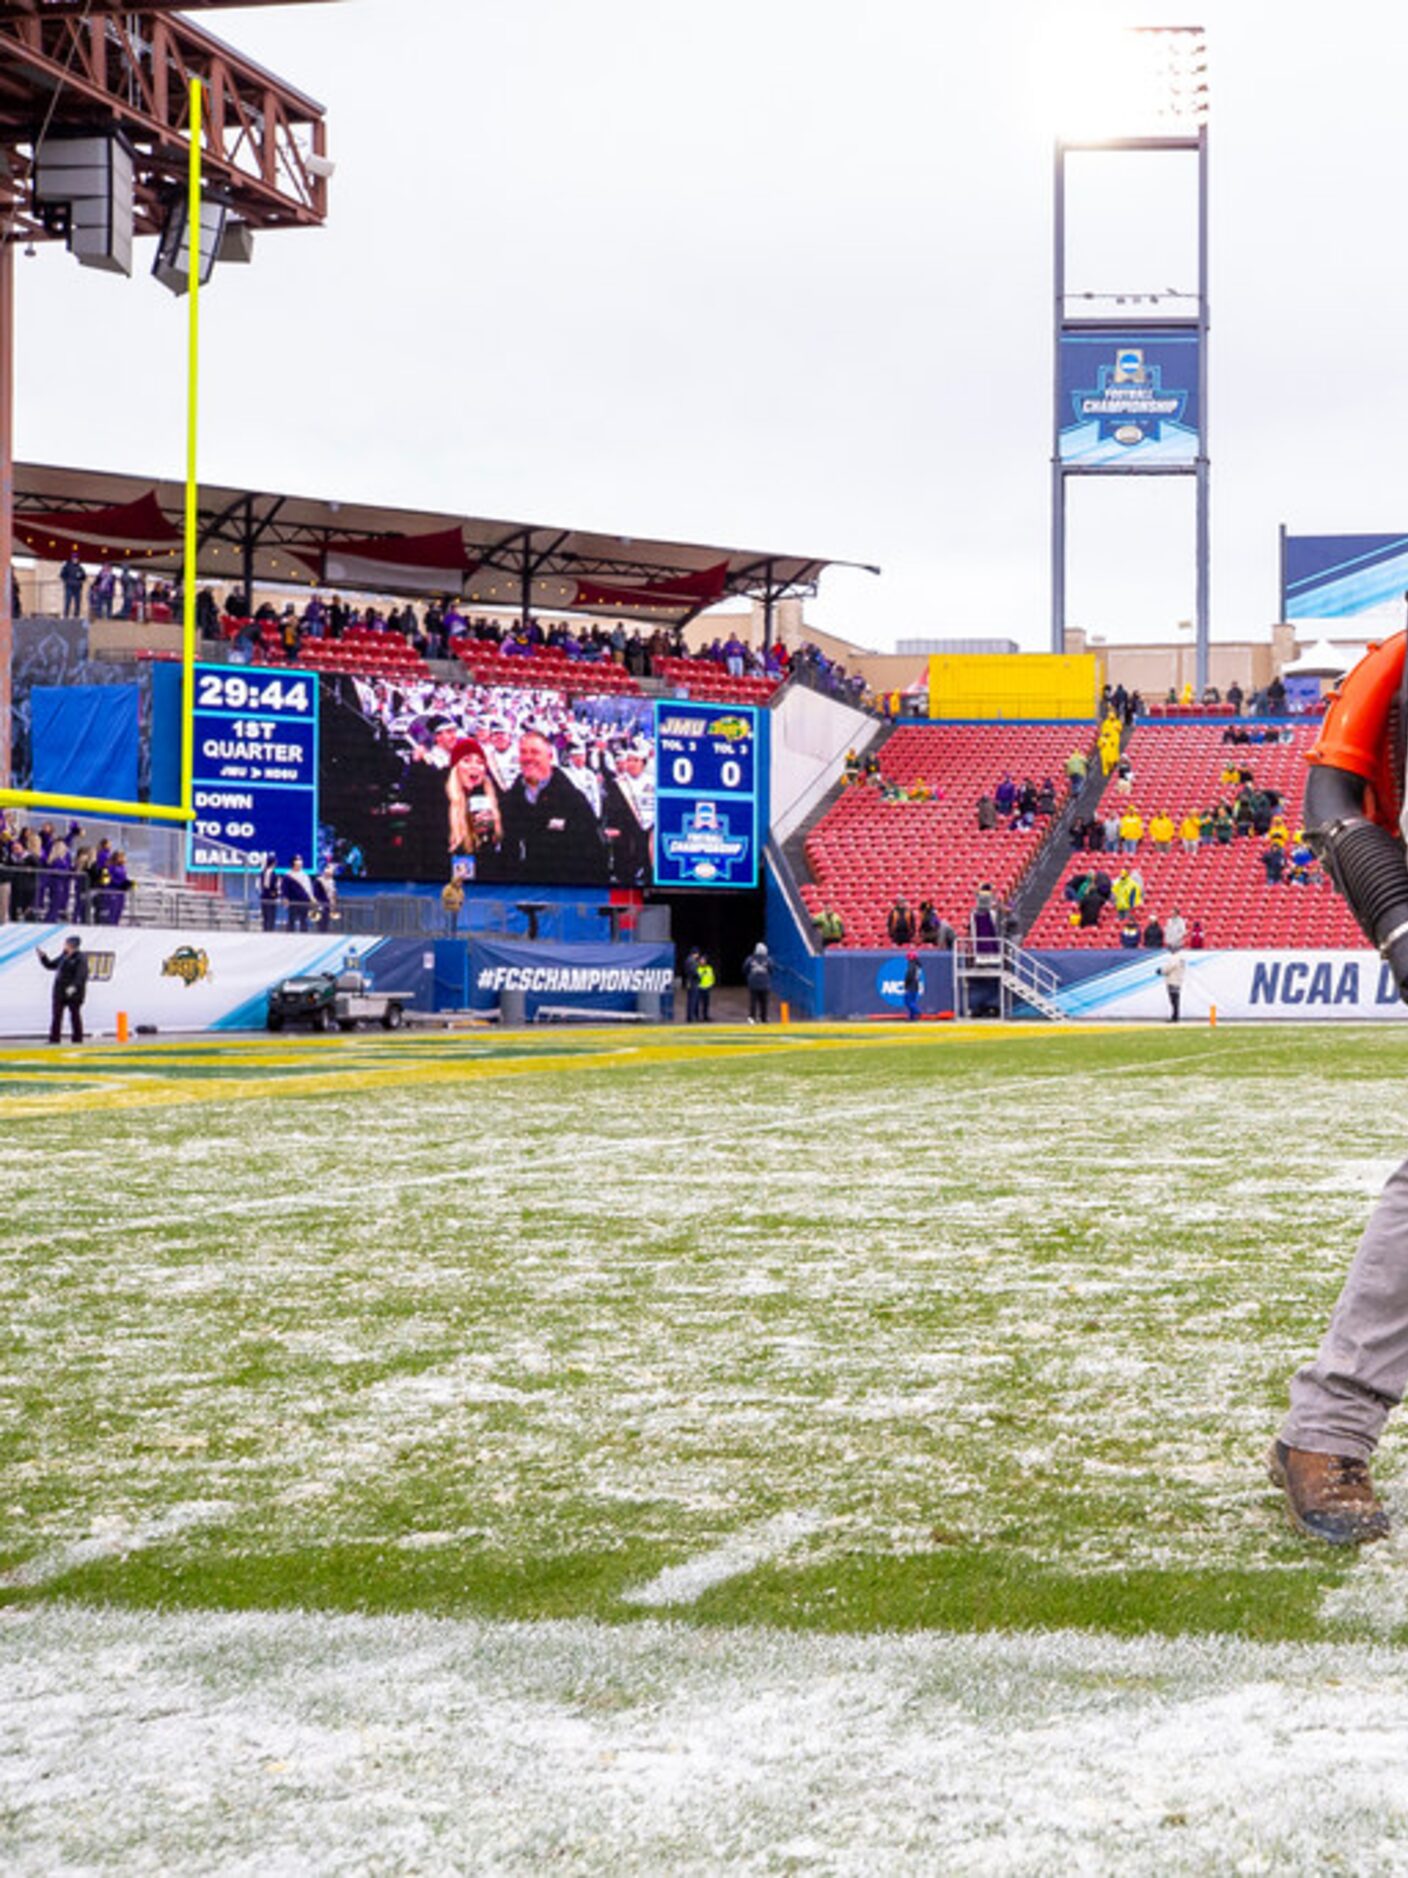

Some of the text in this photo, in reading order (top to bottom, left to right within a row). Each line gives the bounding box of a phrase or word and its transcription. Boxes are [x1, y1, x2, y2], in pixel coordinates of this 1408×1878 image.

[199, 675, 308, 712] 29:44
[232, 720, 276, 740] 1ST
[660, 717, 707, 738] JMU
[203, 739, 304, 763] QUARTER
[673, 757, 694, 785] 0
[721, 760, 742, 788] 0
[195, 791, 253, 809] DOWN
[195, 821, 255, 838] TO GO
[195, 849, 243, 865] BALL
[477, 966, 674, 992] #FCSCHAMPIONSHIP
[1249, 961, 1360, 1005] NCAA
